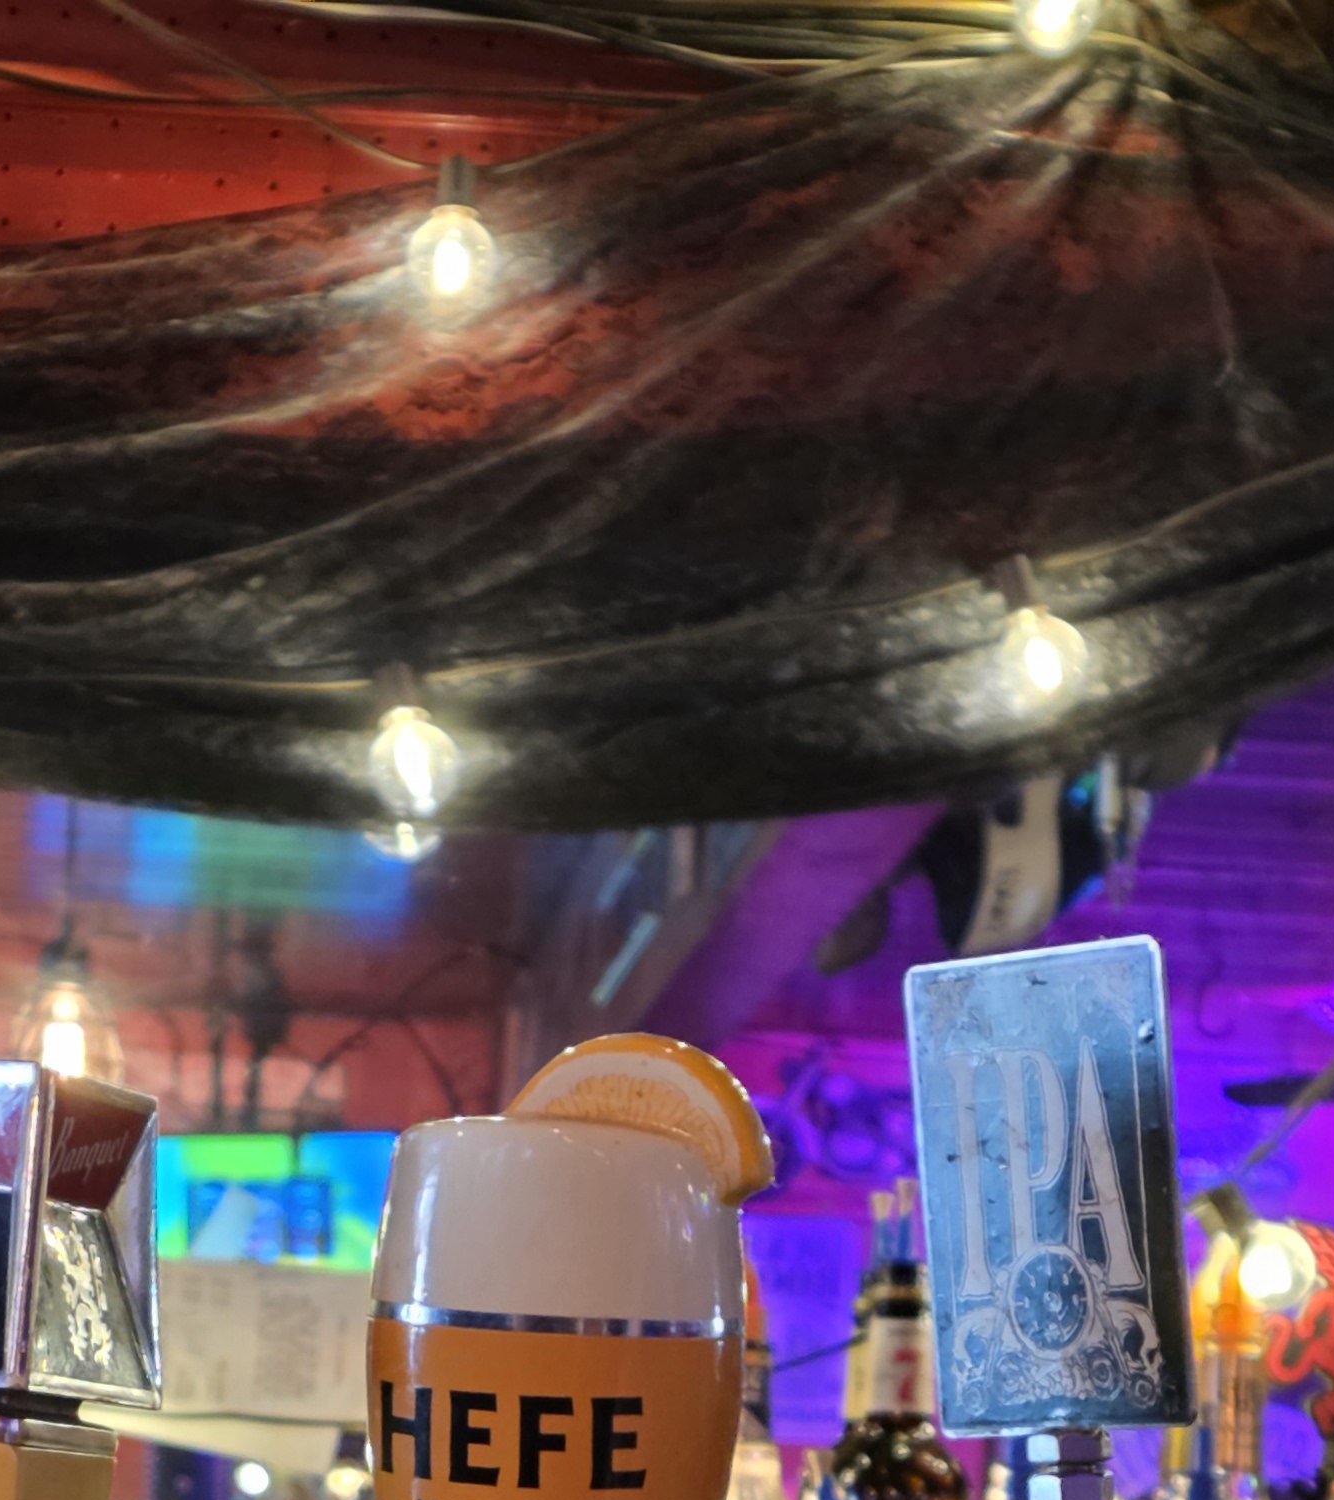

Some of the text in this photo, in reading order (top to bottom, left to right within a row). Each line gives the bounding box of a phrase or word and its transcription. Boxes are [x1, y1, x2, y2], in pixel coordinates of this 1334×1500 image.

[48, 1117, 130, 1179] Banquet
[945, 1036, 1145, 1298] IPA
[379, 1379, 648, 1490] HEFE
